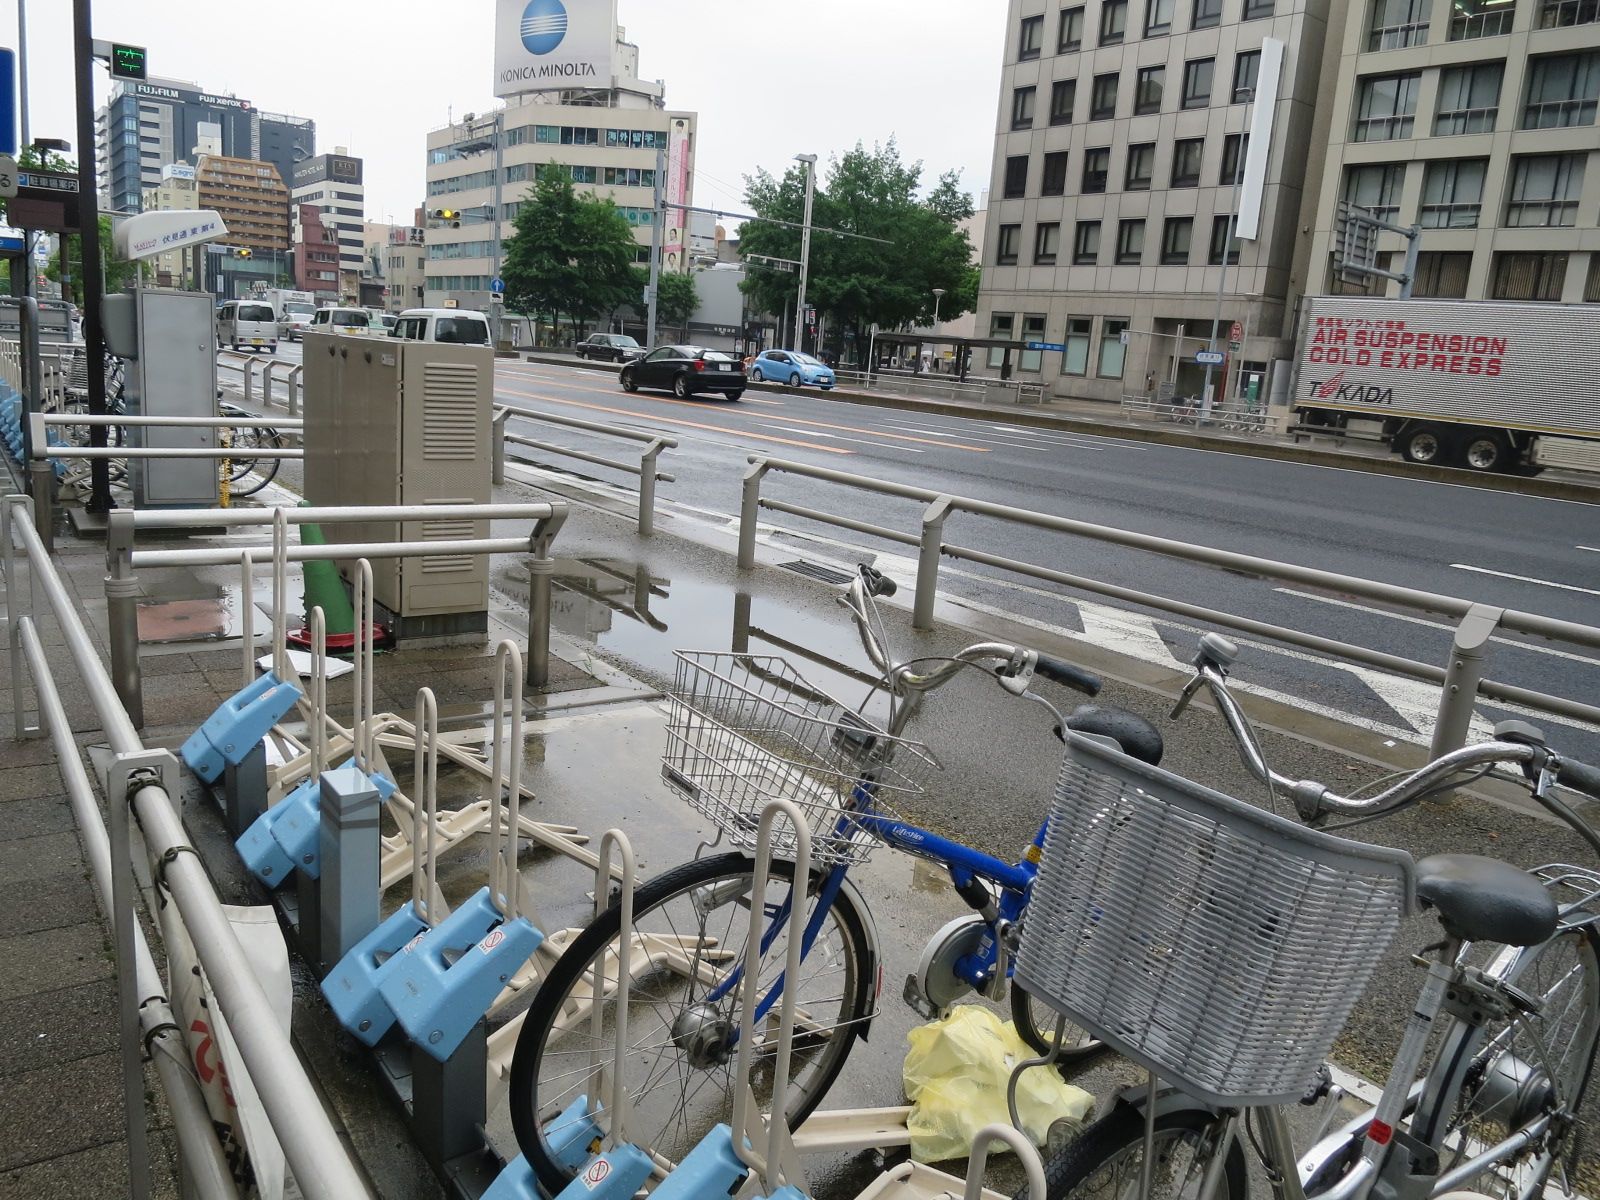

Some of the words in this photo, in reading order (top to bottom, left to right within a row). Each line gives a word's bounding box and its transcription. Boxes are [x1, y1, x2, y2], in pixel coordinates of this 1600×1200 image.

[501, 67, 536, 83] KONICA
[539, 63, 595, 78] MINOLTA
[138, 85, 179, 98] FUJIFILM
[608, 131, 654, 143] 海外留学
[1313, 328, 1348, 344] AIR
[1354, 329, 1507, 355] SUSPENSION
[1310, 346, 1371, 366] COLD
[1380, 351, 1502, 376] EXPRESS
